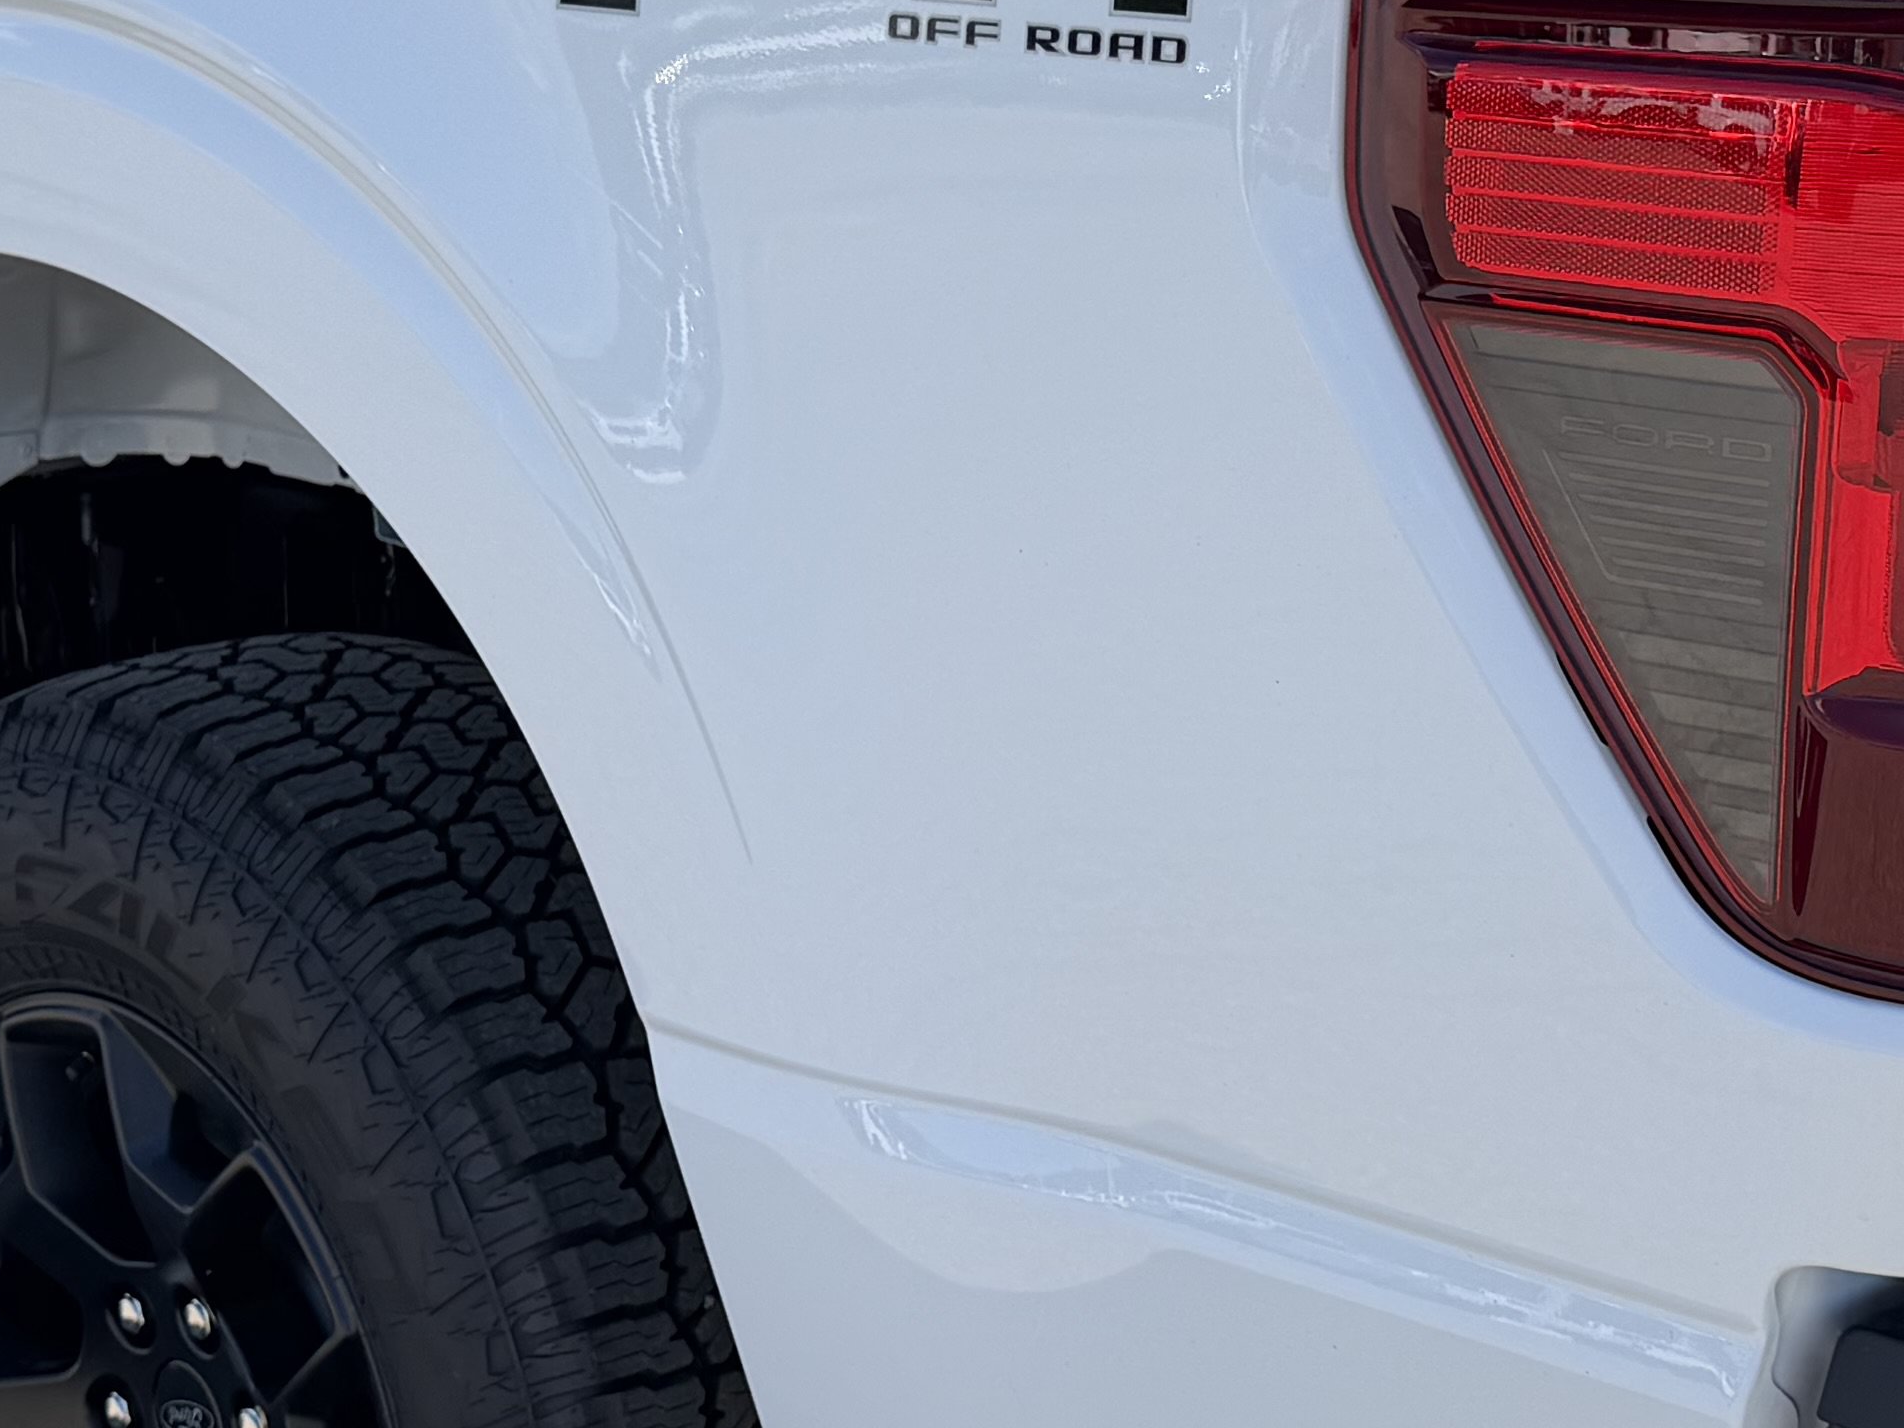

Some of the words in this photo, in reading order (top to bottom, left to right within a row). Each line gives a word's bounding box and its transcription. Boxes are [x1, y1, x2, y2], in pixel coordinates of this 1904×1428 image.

[887, 13, 1000, 49] OFF
[1025, 23, 1189, 65] ROAD
[1562, 417, 1771, 461] FORD
